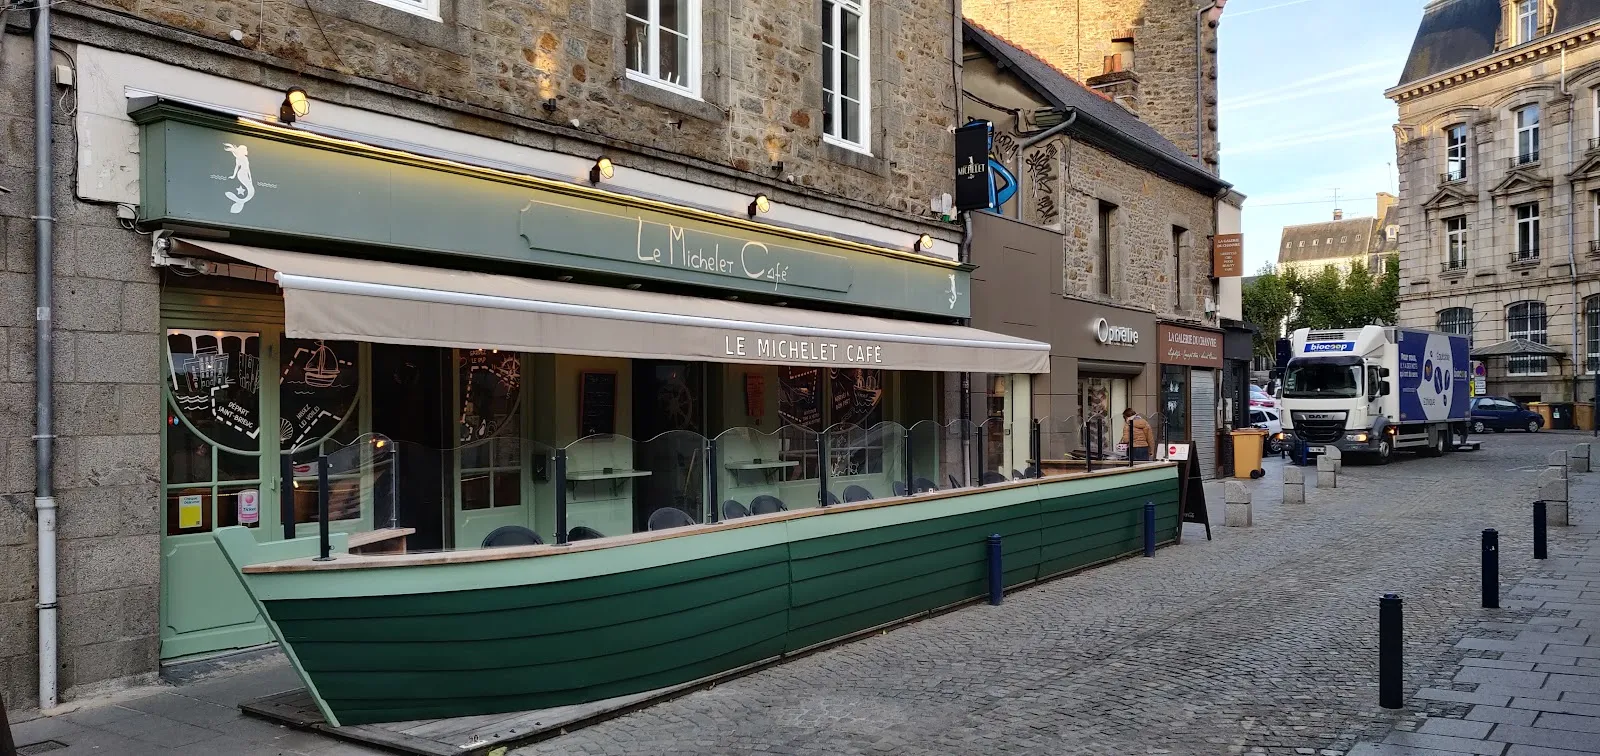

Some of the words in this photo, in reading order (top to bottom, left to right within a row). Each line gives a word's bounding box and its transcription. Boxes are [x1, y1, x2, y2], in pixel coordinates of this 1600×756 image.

[636, 216, 661, 262] Le
[669, 223, 734, 273] Michelet
[741, 241, 789, 291] Café
[725, 336, 746, 356] LE
[758, 338, 838, 361] MICHELET
[846, 345, 882, 363] CAFÉ
[1168, 332, 1174, 342] LA
[1174, 333, 1193, 344] GALERIE
[1193, 335, 1199, 345] DU
[1199, 336, 1217, 348] CHANVRE
[1310, 343, 1347, 351] biocoop
[217, 405, 254, 429] SAINT-BRIEUC
[228, 401, 250, 417] DÉPART
